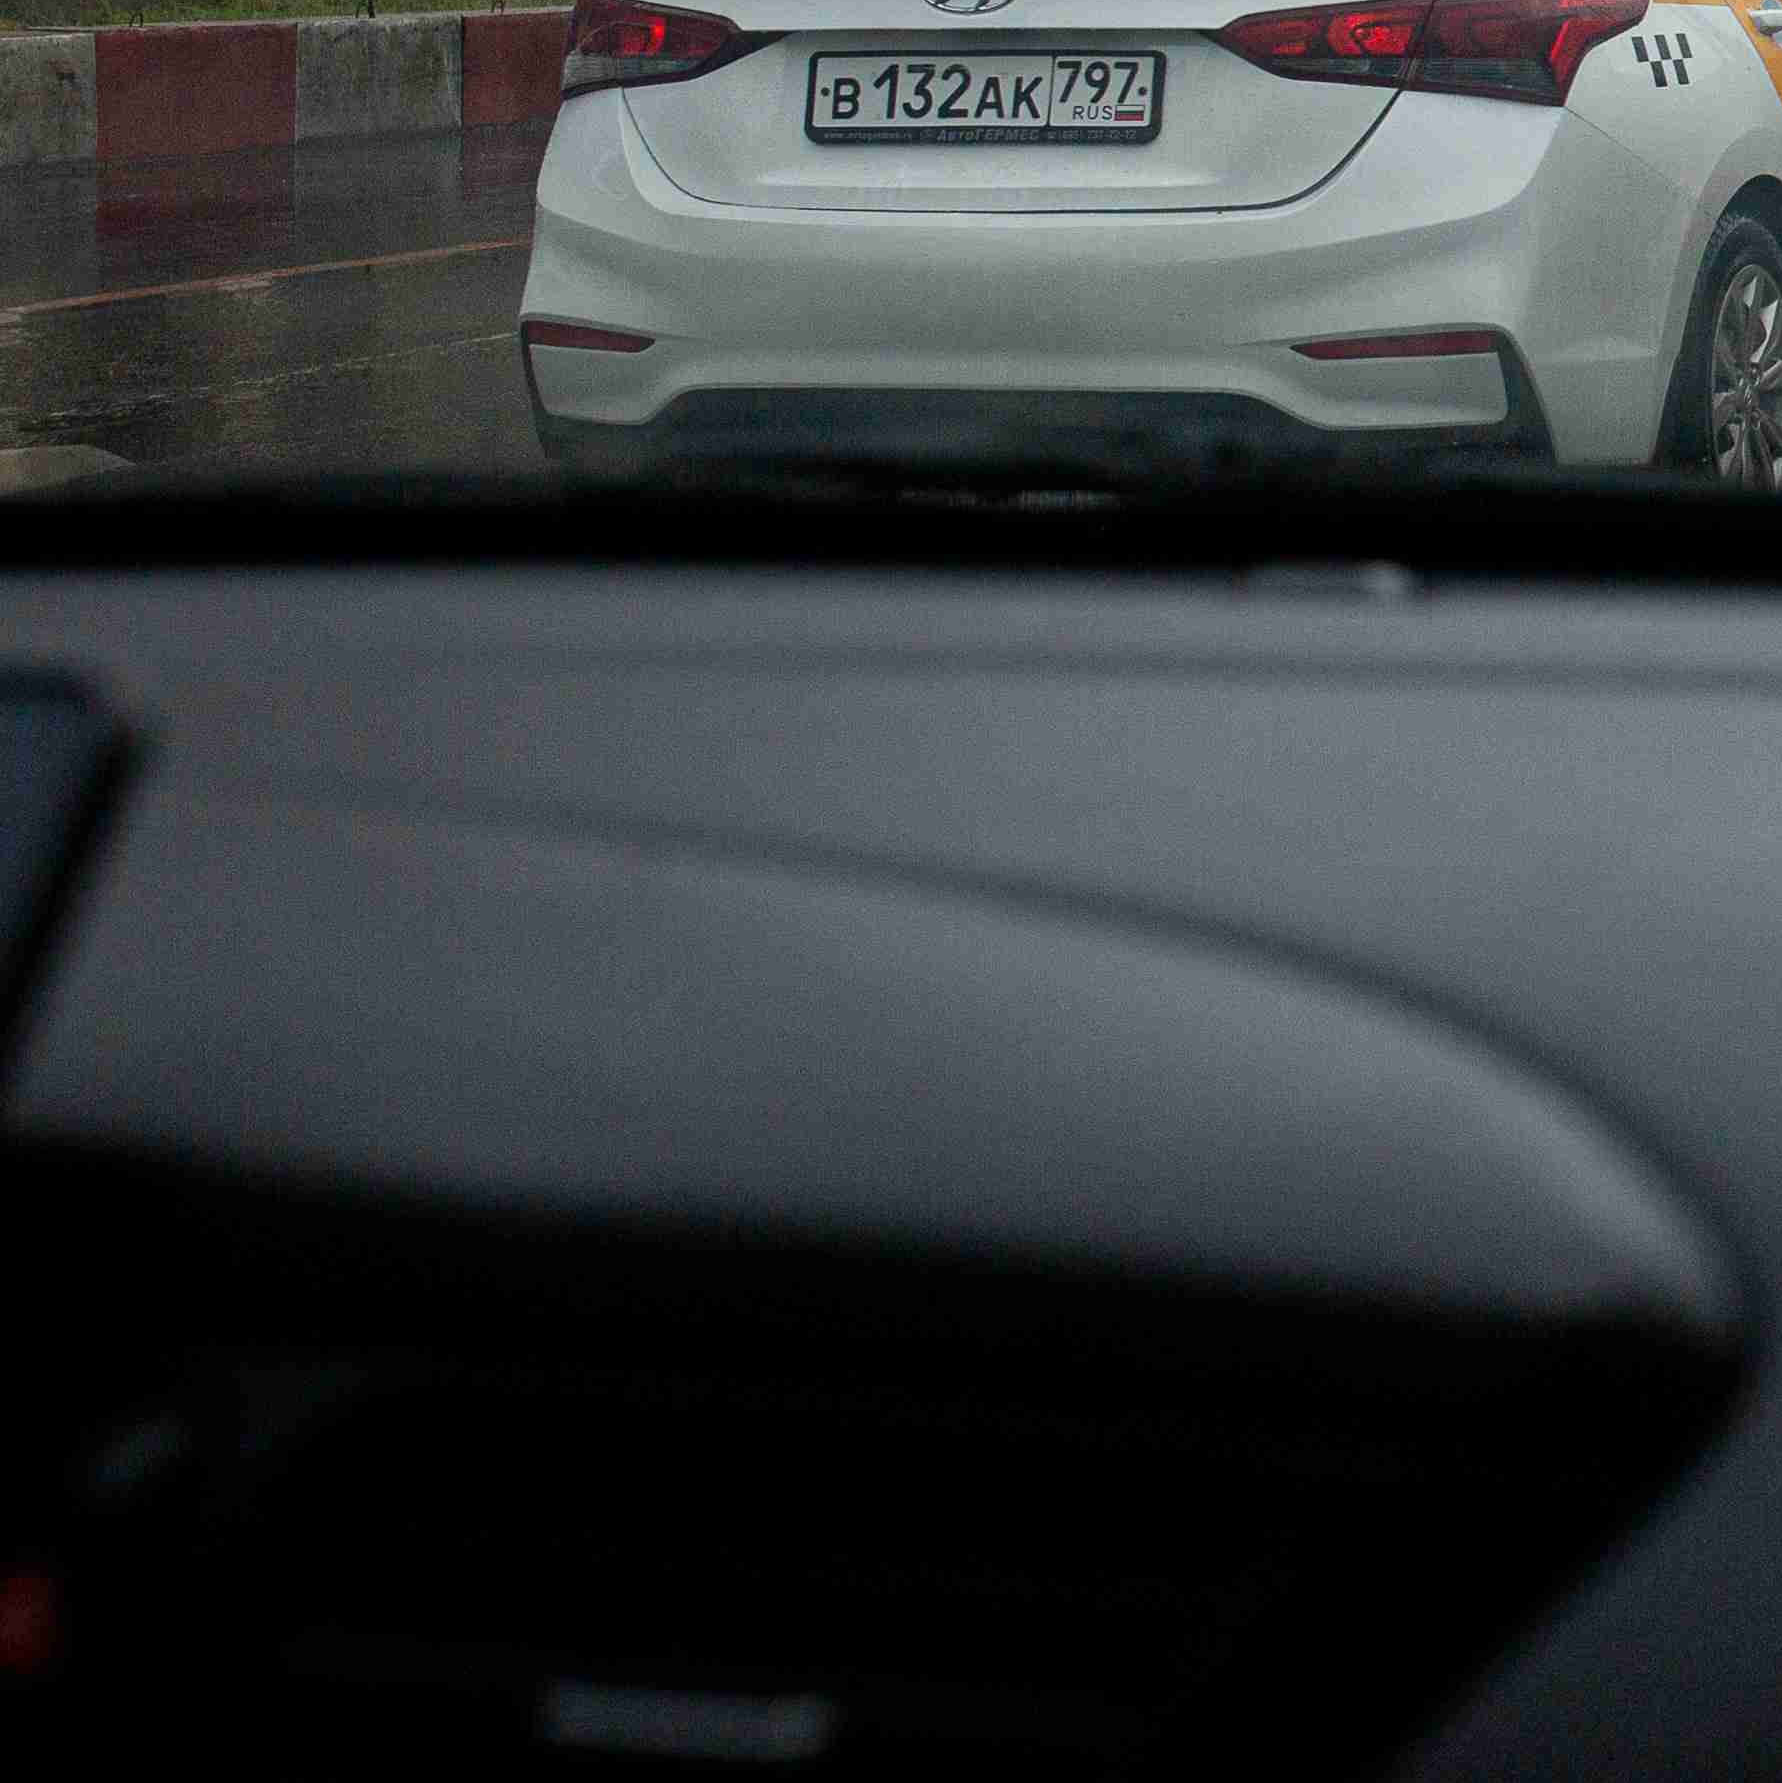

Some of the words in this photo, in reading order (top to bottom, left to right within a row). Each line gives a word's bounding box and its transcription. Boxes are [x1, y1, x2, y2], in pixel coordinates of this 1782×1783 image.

[831, 63, 1044, 121] В132АК
[1056, 60, 1140, 104] 797
[1072, 105, 1114, 122] RUS
